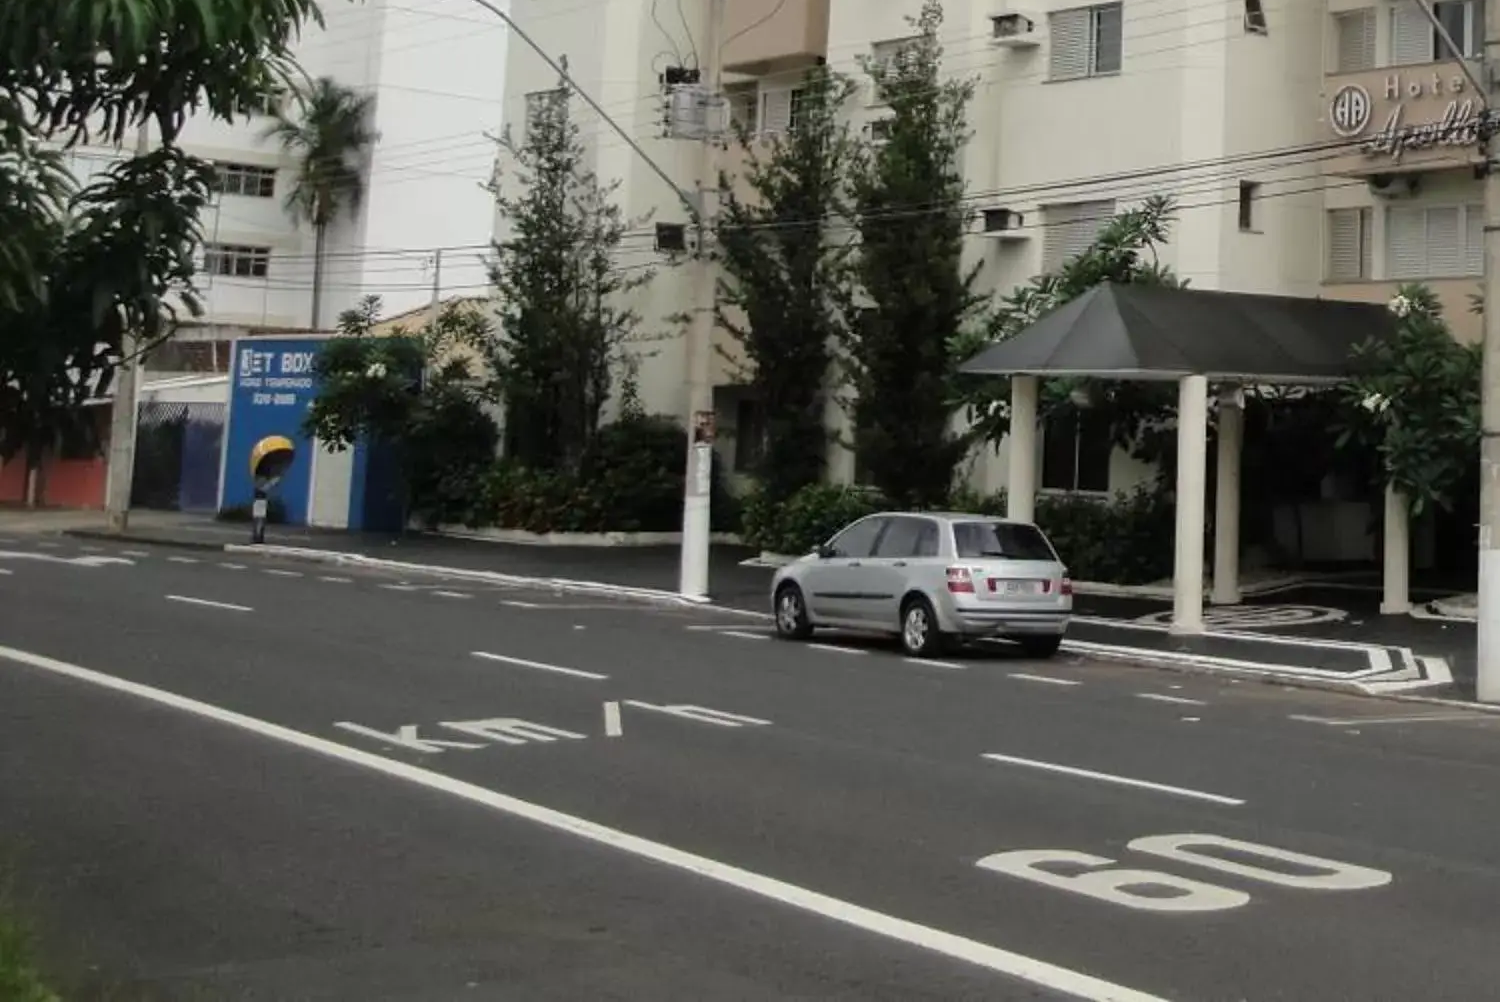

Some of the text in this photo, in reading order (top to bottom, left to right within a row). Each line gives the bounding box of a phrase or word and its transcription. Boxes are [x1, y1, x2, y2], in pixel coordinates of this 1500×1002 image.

[1384, 71, 1467, 99] Hote
[281, 352, 314, 374] BOX
[975, 832, 1393, 912] 60
